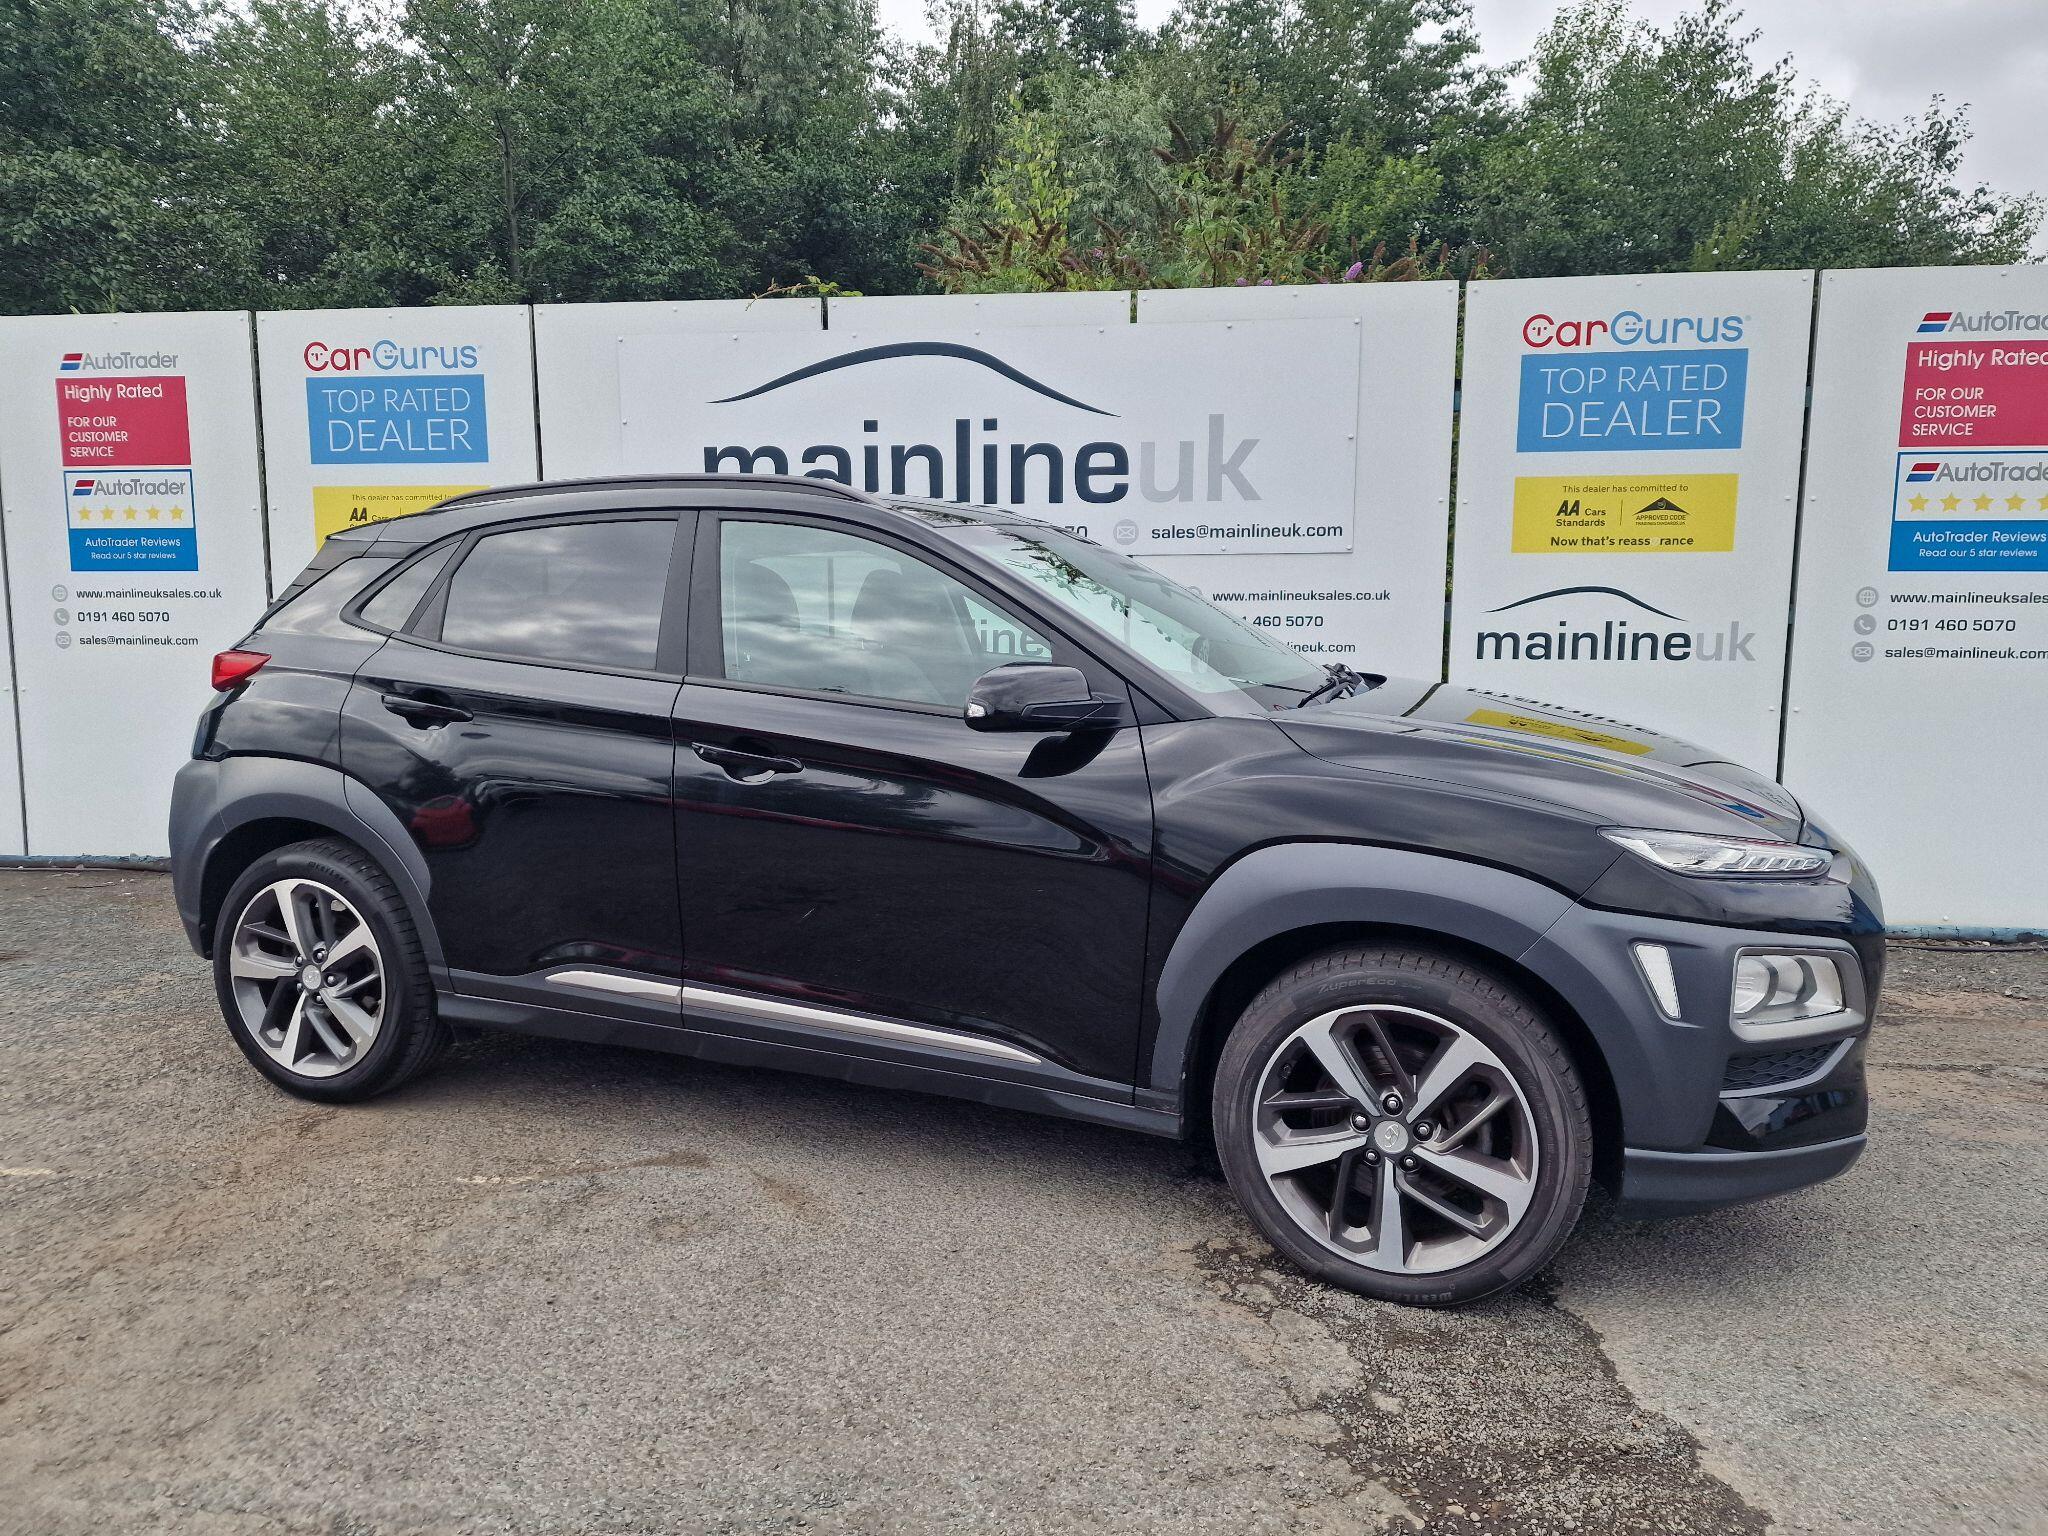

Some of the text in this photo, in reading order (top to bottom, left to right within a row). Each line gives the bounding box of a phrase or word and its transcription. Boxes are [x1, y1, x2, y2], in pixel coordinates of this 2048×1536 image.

[1523, 310, 1744, 348] CarGurus
[82, 352, 178, 370] AutoTrader
[304, 339, 477, 371] CarGurus
[1918, 350, 1985, 371] Highly
[1539, 364, 1727, 395] TOP RATED
[65, 384, 162, 403] Highly Rated
[1916, 387, 1984, 400] FOR OUR
[322, 388, 471, 413] TOP RATED
[1914, 405, 1997, 418] CUSTOMER
[68, 416, 117, 428] FOR OUR
[1542, 399, 1722, 438] DEALER
[328, 418, 473, 452] DEALER
[1912, 423, 1974, 436] SERVICE
[69, 431, 128, 443] CUSTOMER
[70, 447, 114, 457] SERVICE
[94, 479, 186, 496] AutoTrader
[1582, 485, 1610, 493] dealer
[1630, 484, 1677, 492] committed
[349, 507, 367, 522] AA
[1556, 500, 1606, 516] AA Cars
[1556, 519, 1605, 527] Standards
[1151, 523, 1343, 539] sales@mainlineuk.com
[1912, 531, 2047, 543] AutoTrader Reviews
[85, 537, 181, 548] AutoTrader Reviews
[1551, 536, 1694, 546] Now that's reassrance
[91, 552, 111, 560] Read
[127, 552, 132, 560] 5
[133, 552, 147, 560] star
[148, 552, 176, 560] reviews
[1919, 548, 1946, 557] Read
[1970, 549, 1975, 557] 5
[1978, 548, 1997, 557] star
[2000, 549, 2038, 557] reviews
[76, 587, 222, 599] www.mainlineuksales.co.uk
[1212, 589, 1391, 601] www.mainlineuksales.co.uk
[77, 611, 170, 622] 0191 460 5070
[1253, 616, 1282, 627] 460
[1285, 616, 1324, 627] 5070
[1888, 619, 2016, 631] 0191 460 5070
[79, 635, 199, 647] sales@mainlineuk.com
[1476, 620, 1756, 662] mainlineuk
[1885, 647, 2048, 660] sales@mainlineuk.com
